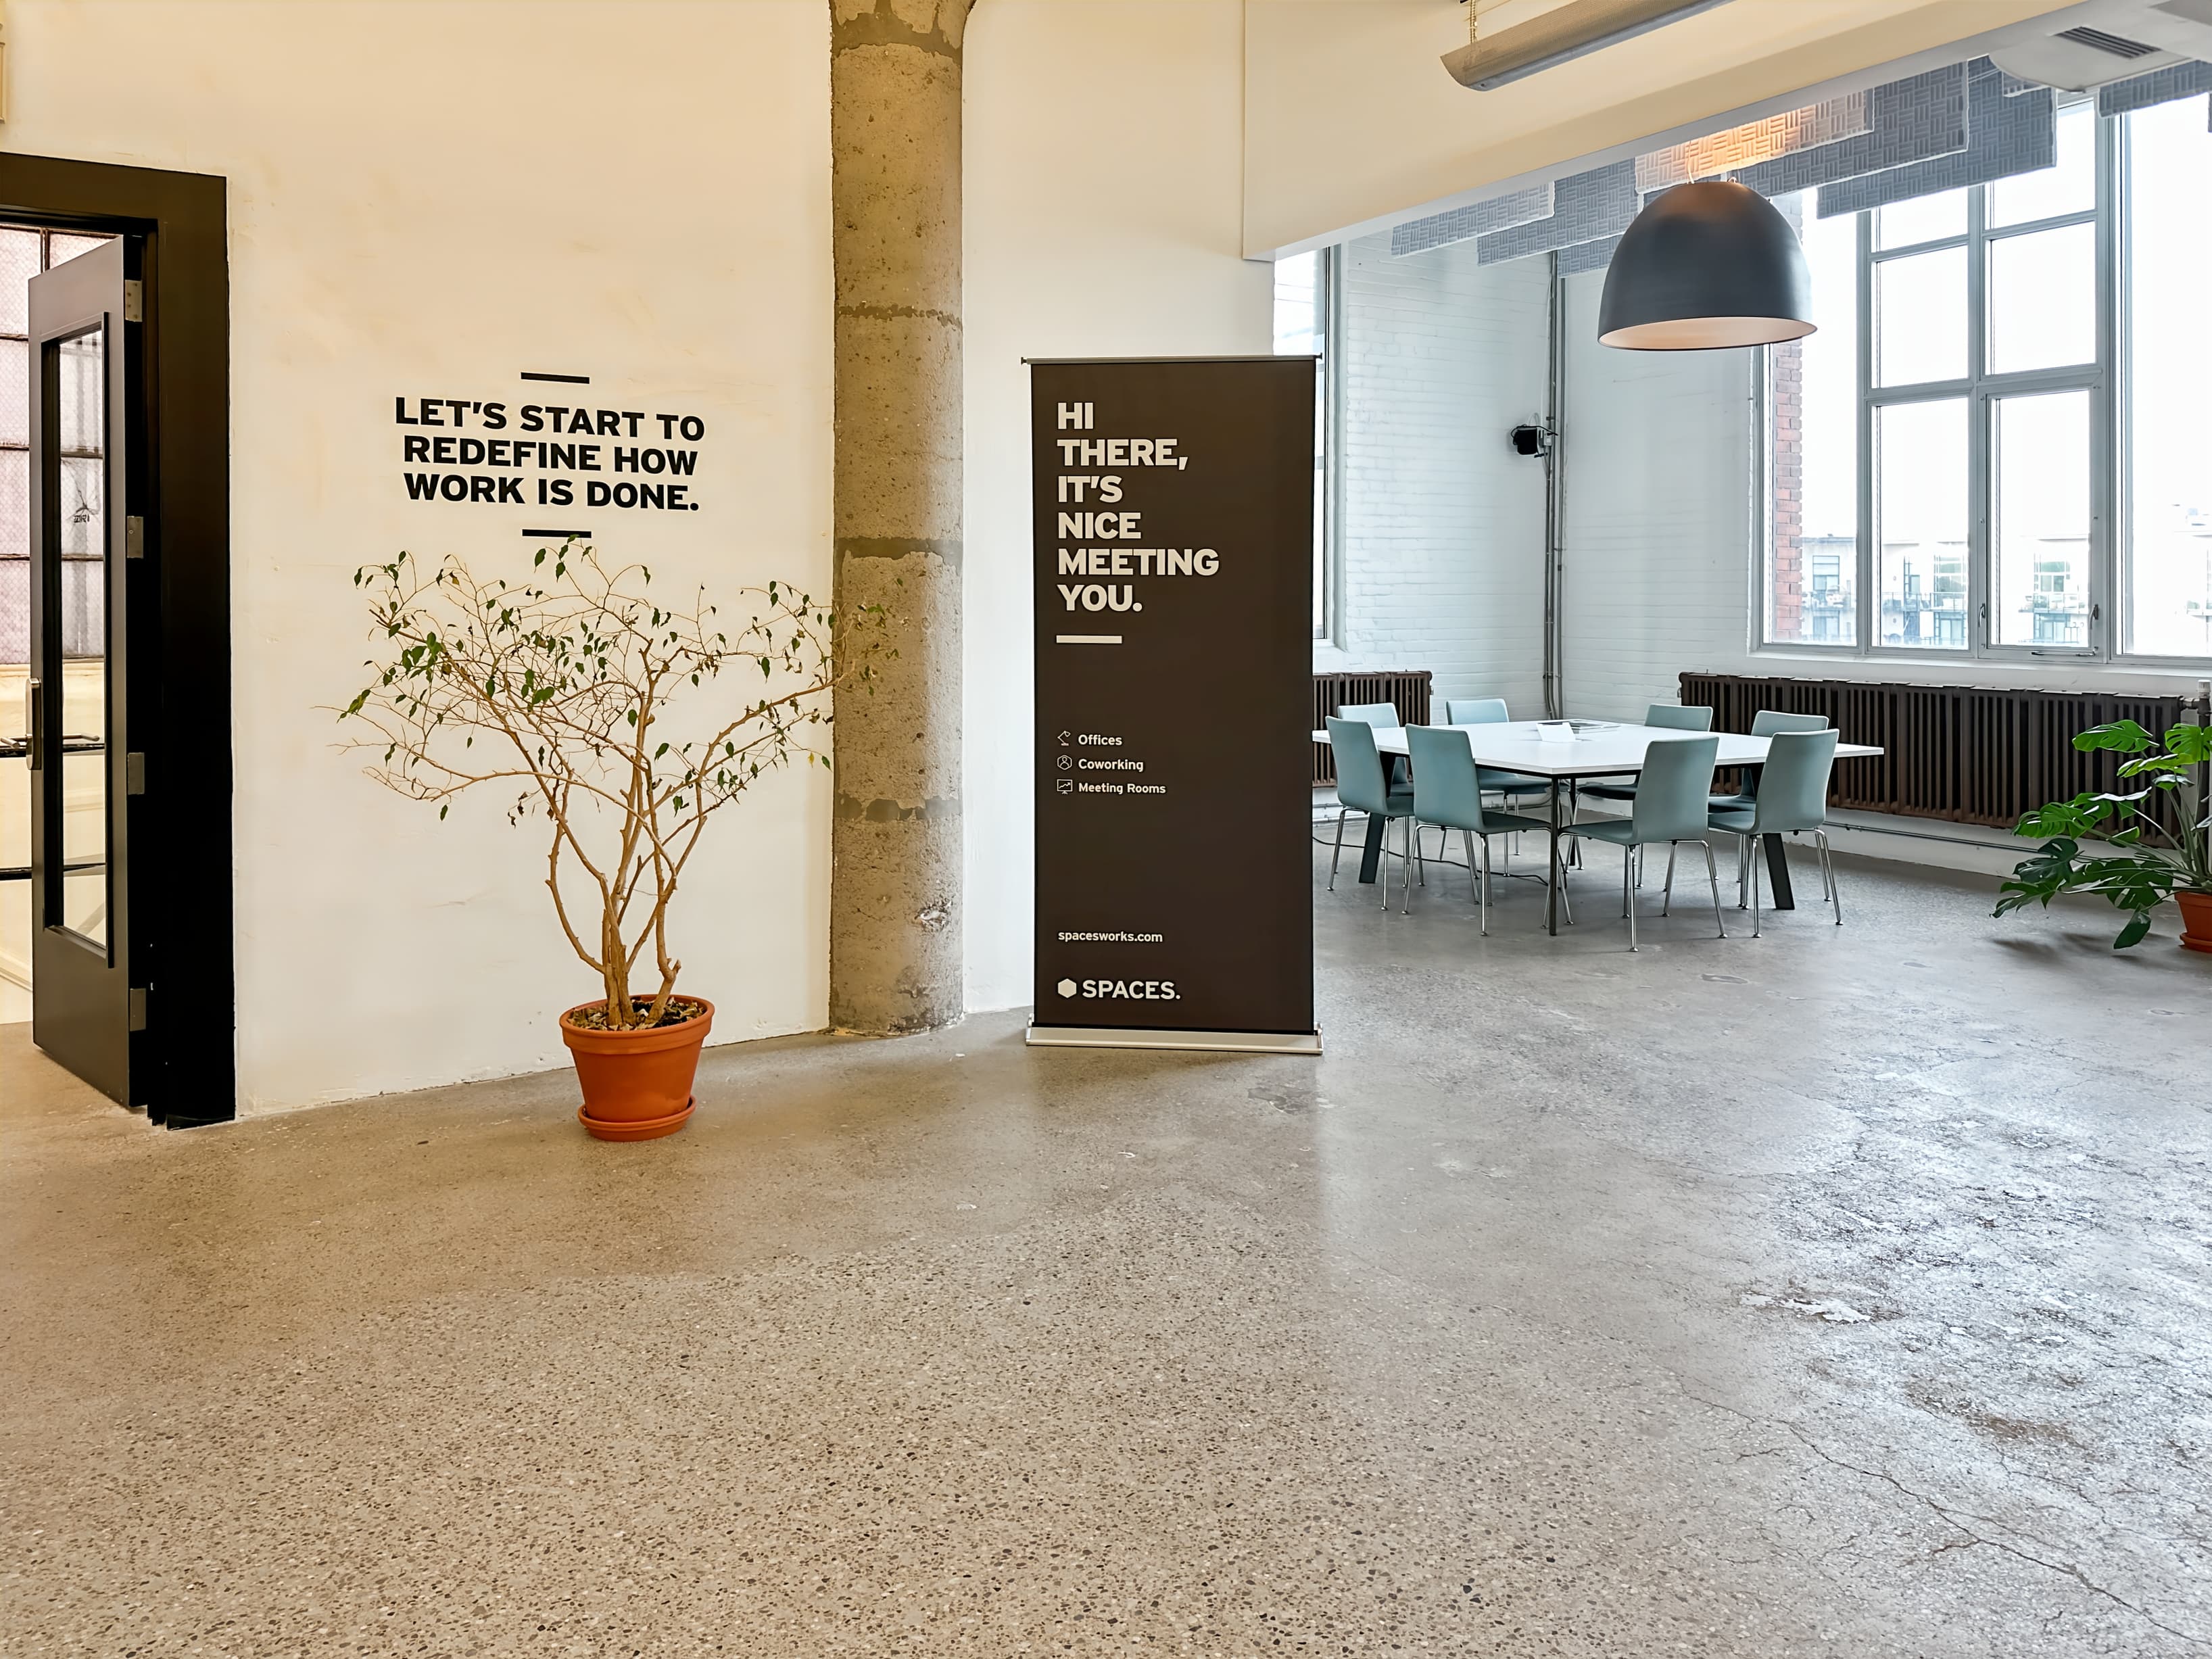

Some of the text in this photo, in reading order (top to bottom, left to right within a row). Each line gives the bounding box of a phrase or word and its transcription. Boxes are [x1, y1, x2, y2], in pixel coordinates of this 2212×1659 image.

[396, 397, 704, 441] LET'S START TO
[1058, 403, 1093, 429] HI
[405, 435, 698, 475] REDEFINE HOW
[1057, 439, 1188, 470] THERE,
[404, 473, 698, 510] WORK IS DONE.
[1059, 476, 1122, 502] IT'S
[1059, 512, 1141, 539] NICE
[1059, 549, 1219, 575] MEETING
[1057, 585, 1142, 611] YOU.
[1078, 734, 1122, 746] Offices
[1078, 759, 1144, 773] Coworking
[1078, 782, 1166, 795] Meeting Rooms
[1058, 931, 1163, 942] spacesworks.com
[1082, 980, 1181, 1000] SPACES.
